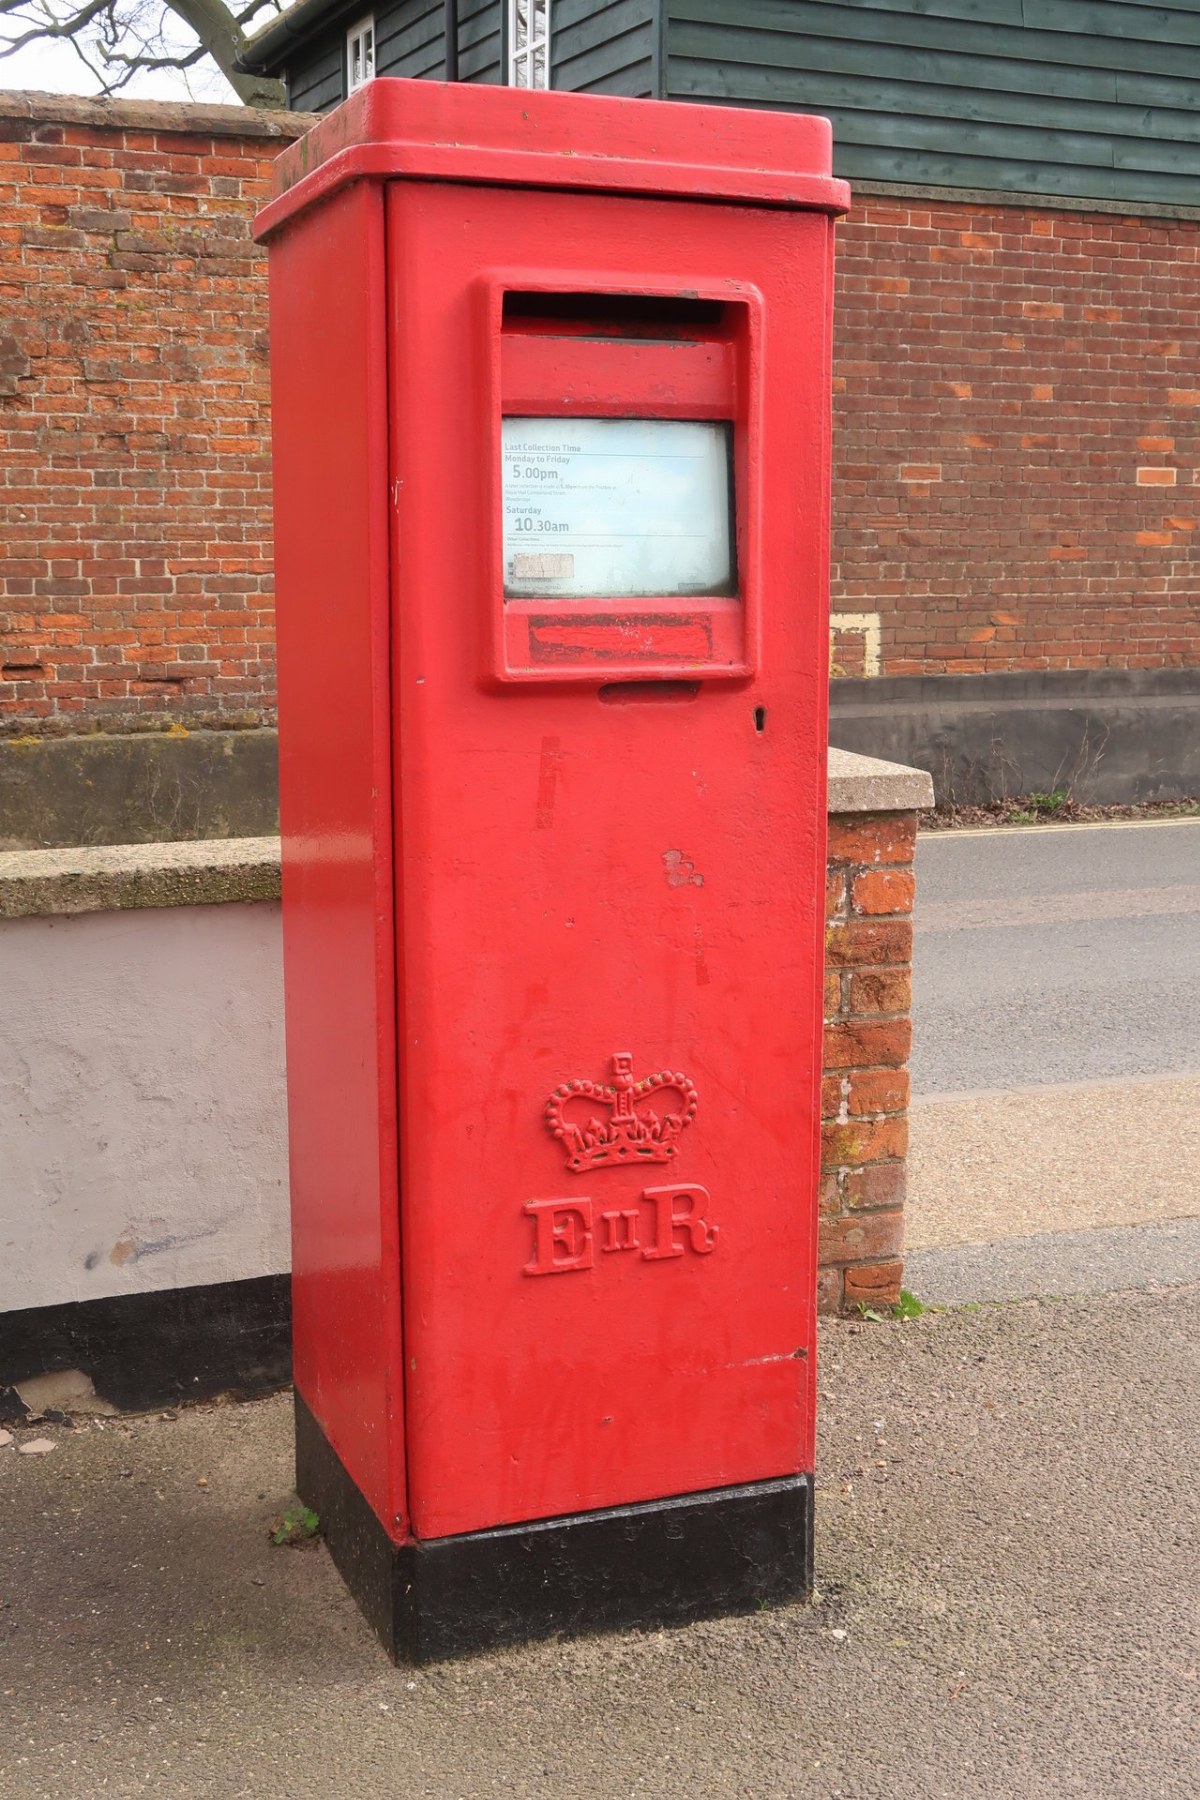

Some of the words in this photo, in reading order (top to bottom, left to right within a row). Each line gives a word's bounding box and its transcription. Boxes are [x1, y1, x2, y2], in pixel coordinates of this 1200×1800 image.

[505, 443, 522, 452] Last
[523, 443, 561, 452] Collection
[562, 444, 581, 453] Time
[505, 455, 535, 464] Monday
[546, 456, 570, 465] Friday
[513, 464, 559, 481] 5.00pm
[506, 506, 542, 515] Saturday
[514, 517, 570, 532] 10.30am
